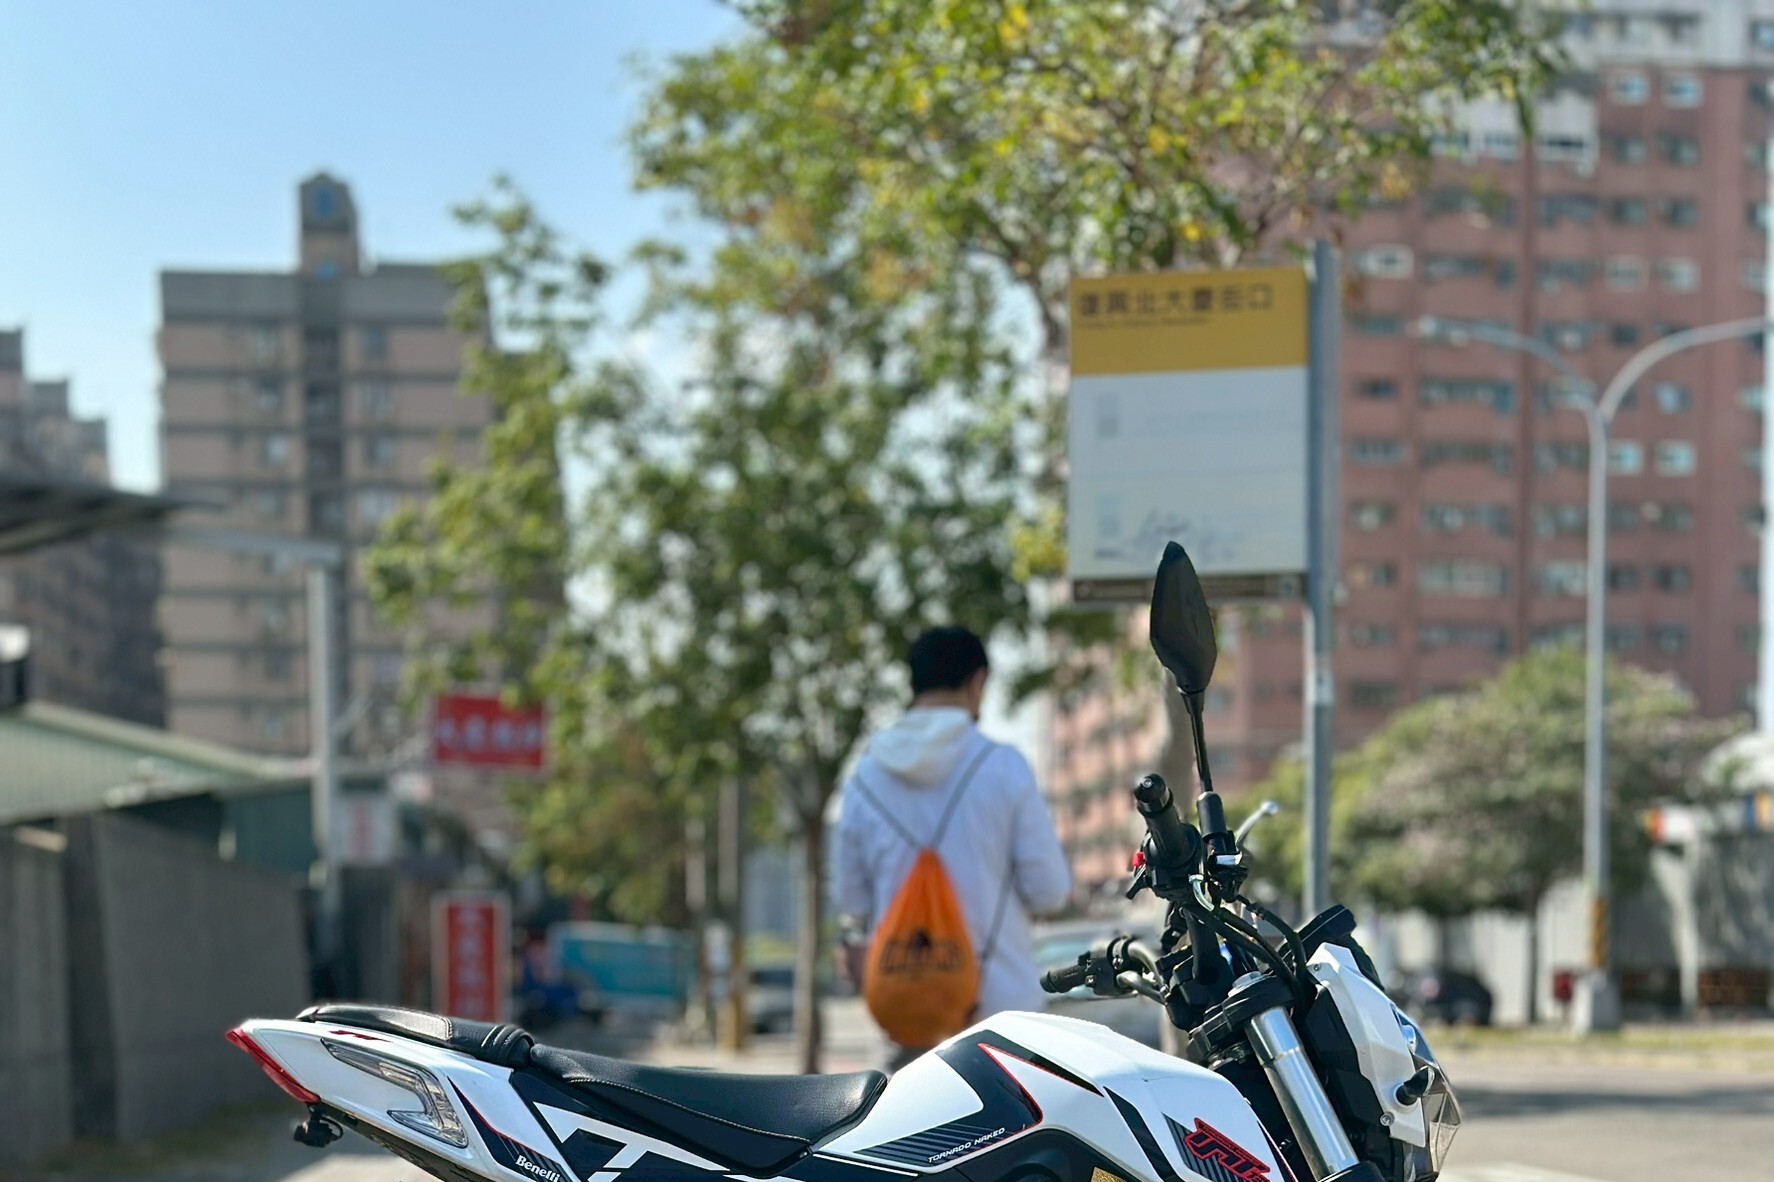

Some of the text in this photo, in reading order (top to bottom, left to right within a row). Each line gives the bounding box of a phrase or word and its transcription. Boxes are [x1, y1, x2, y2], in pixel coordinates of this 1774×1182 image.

[927, 1127, 1006, 1163] TORNADO NAKED
[515, 1155, 561, 1182] Benelli
